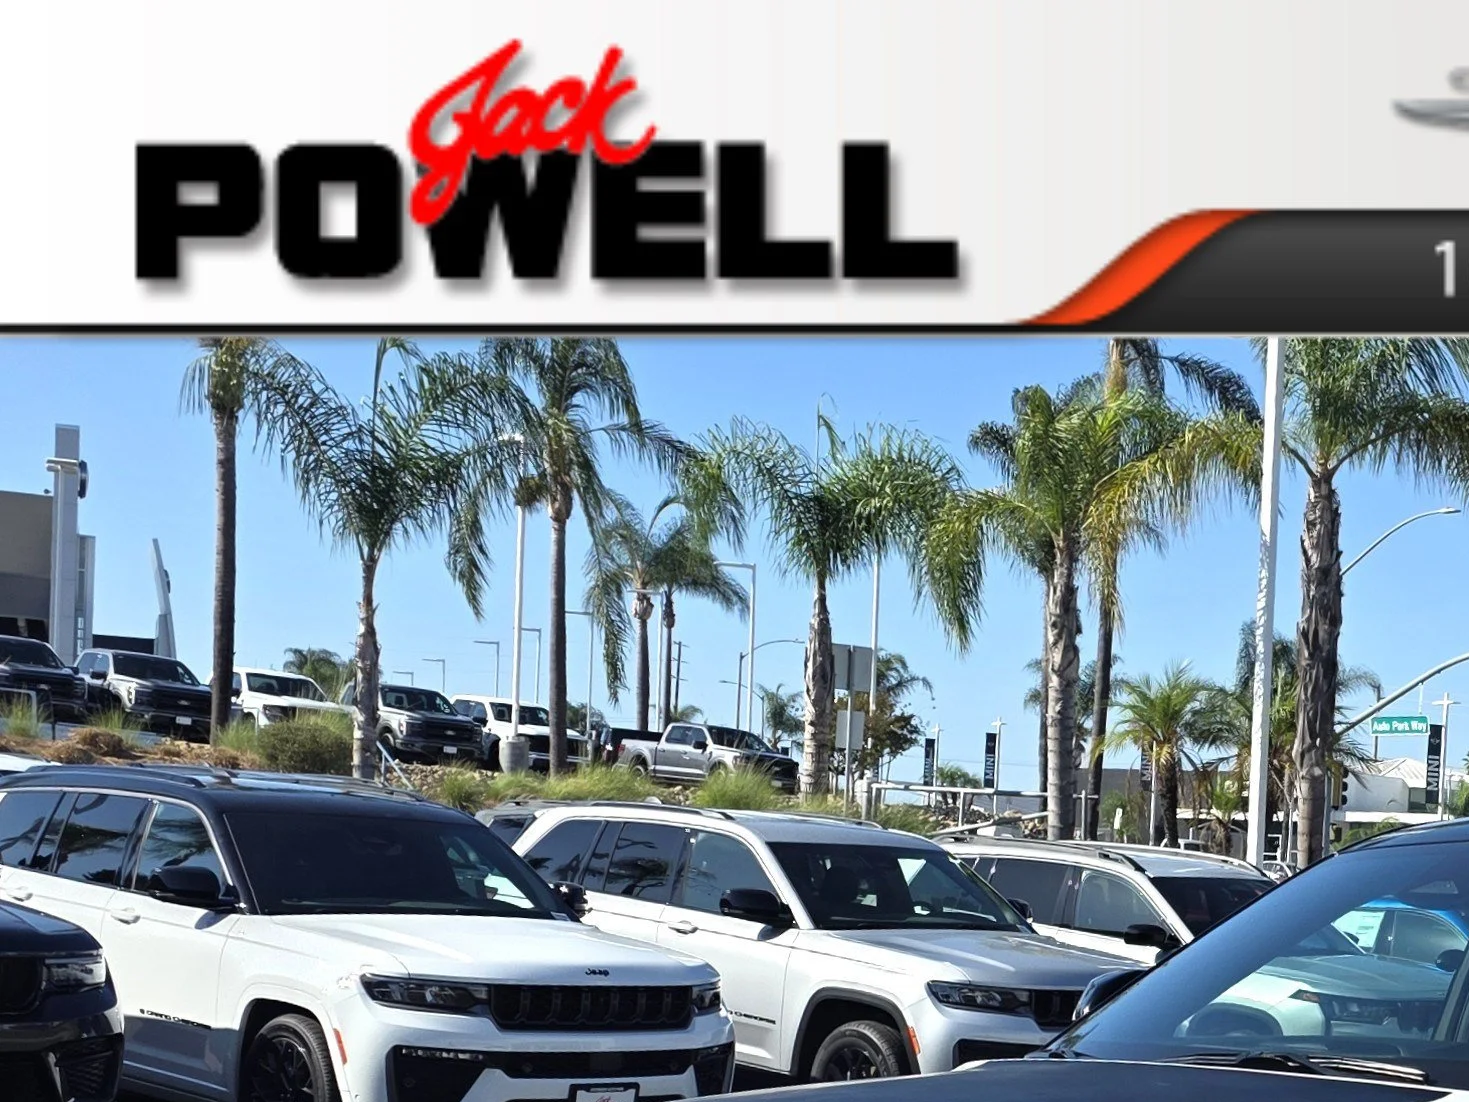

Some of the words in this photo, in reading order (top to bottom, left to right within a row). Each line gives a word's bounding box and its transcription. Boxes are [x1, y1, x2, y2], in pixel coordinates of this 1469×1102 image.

[1372, 720, 1391, 732] Auto
[1392, 720, 1410, 732] Park
[1411, 720, 1427, 733] Way
[985, 753, 996, 780] MINI
[1426, 754, 1440, 791] MINI
